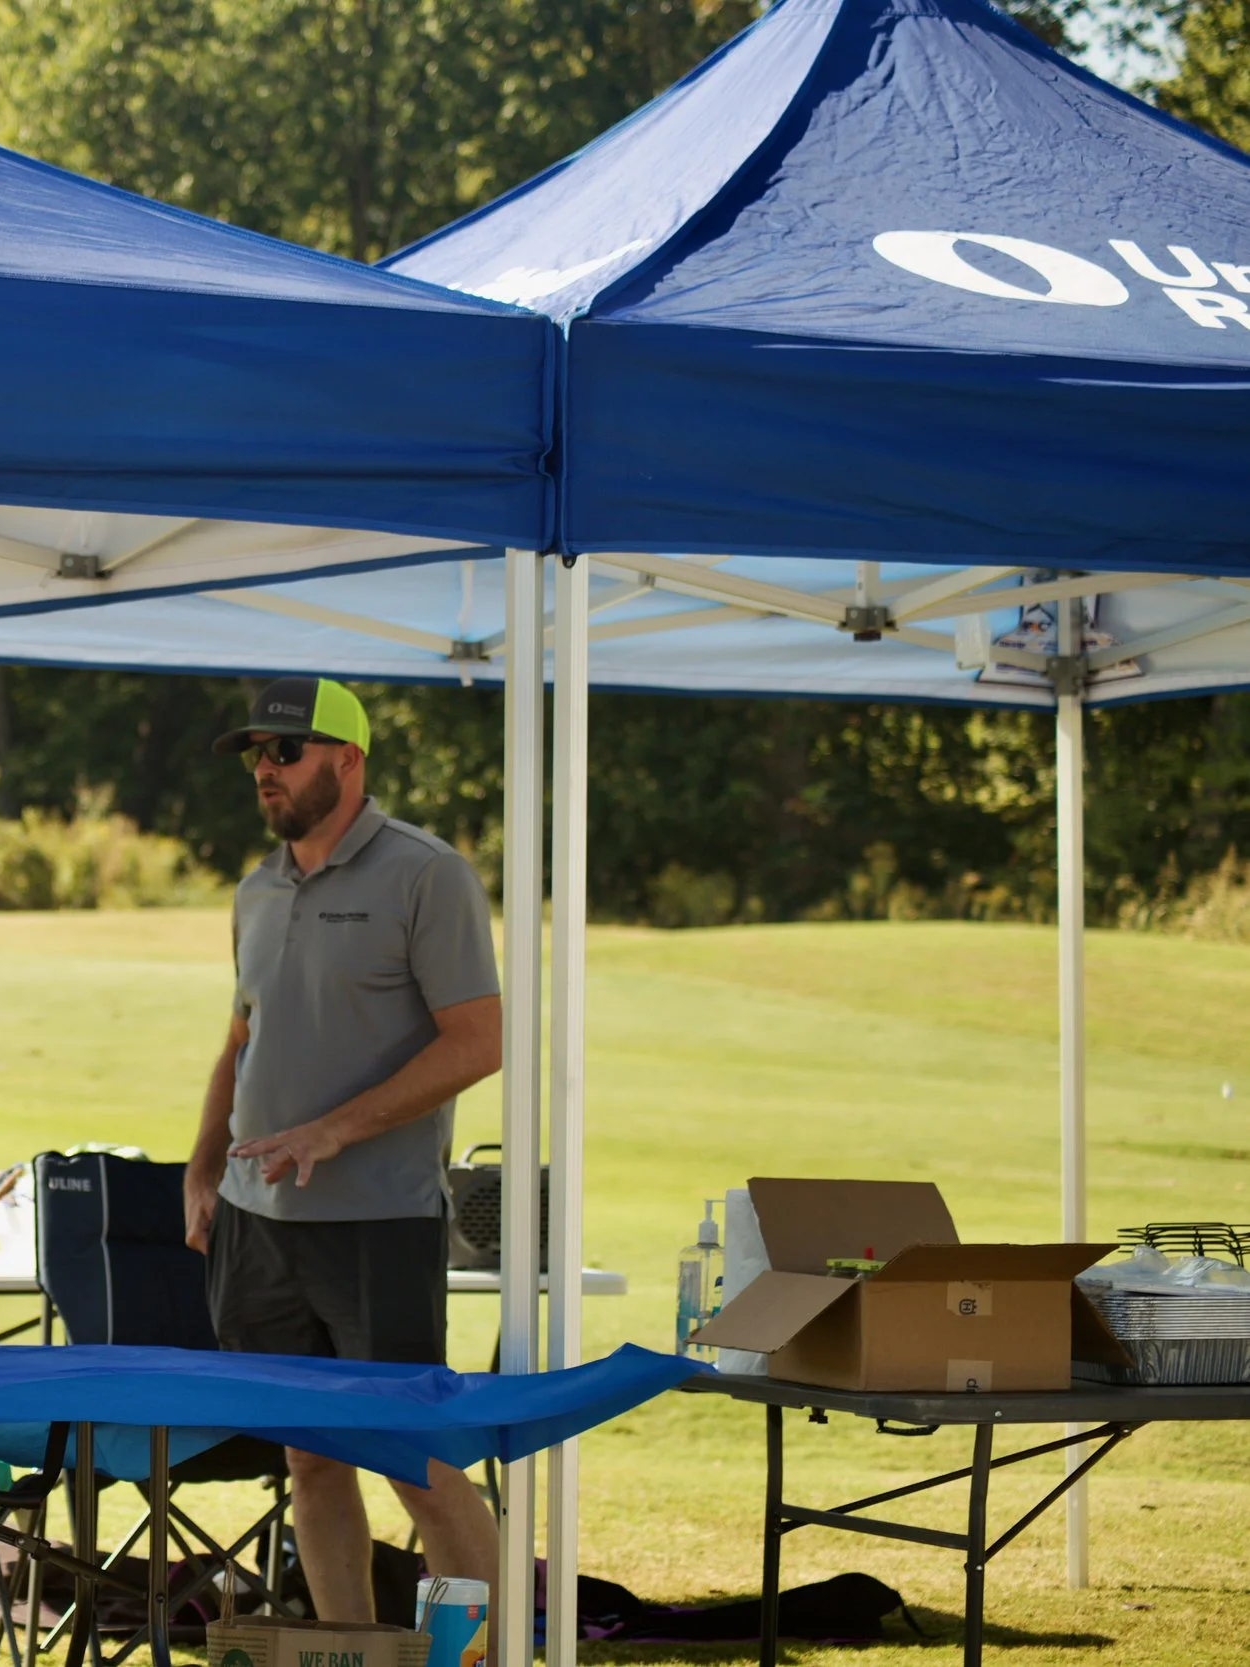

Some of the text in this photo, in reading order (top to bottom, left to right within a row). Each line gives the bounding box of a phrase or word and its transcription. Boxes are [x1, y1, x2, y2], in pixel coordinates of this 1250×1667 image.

[47, 1176, 92, 1192] ULINE
[298, 1651, 365, 1667] WE BAN
